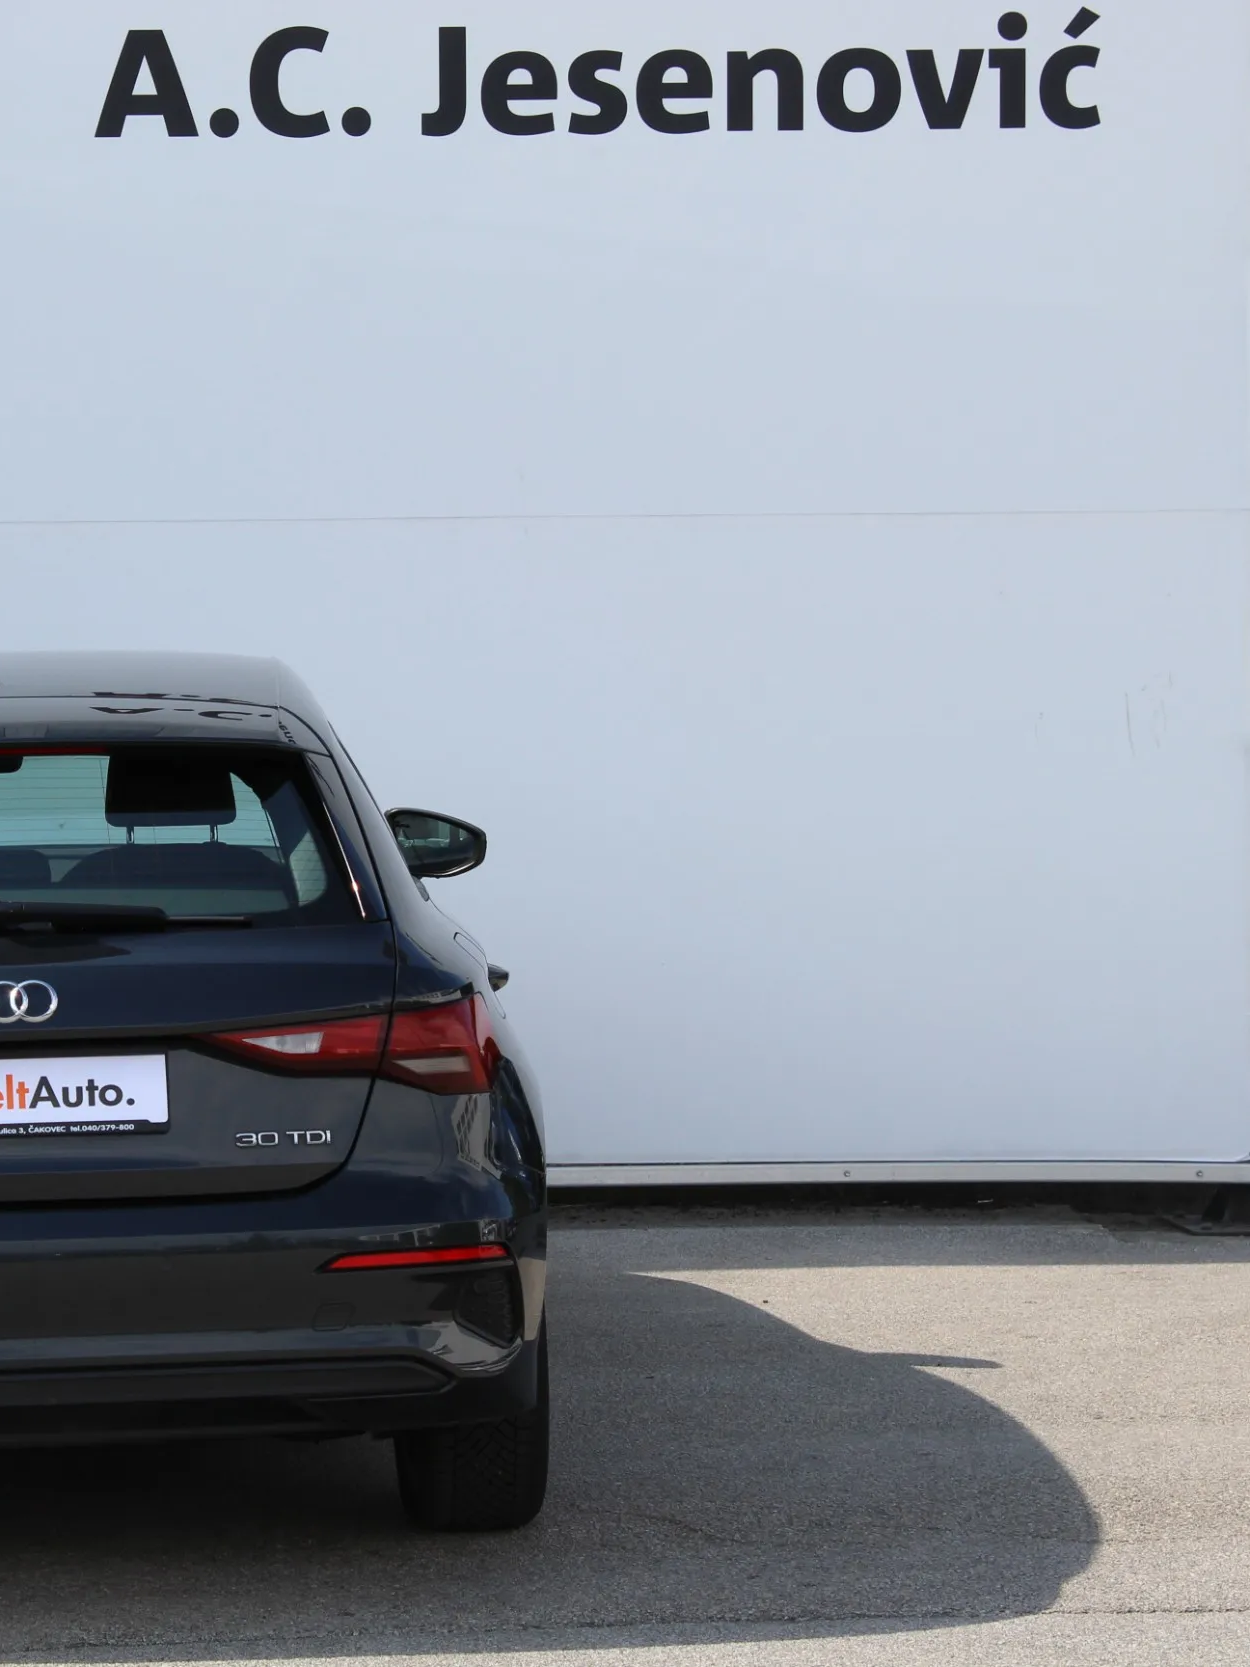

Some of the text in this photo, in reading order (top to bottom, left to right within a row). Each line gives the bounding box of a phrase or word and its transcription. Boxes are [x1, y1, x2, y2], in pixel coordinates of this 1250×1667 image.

[95, 7, 1101, 138] A.C. Jesenović
[28, 1125, 67, 1134] ČAKOVEC
[235, 1130, 331, 1147] 30 TDI
